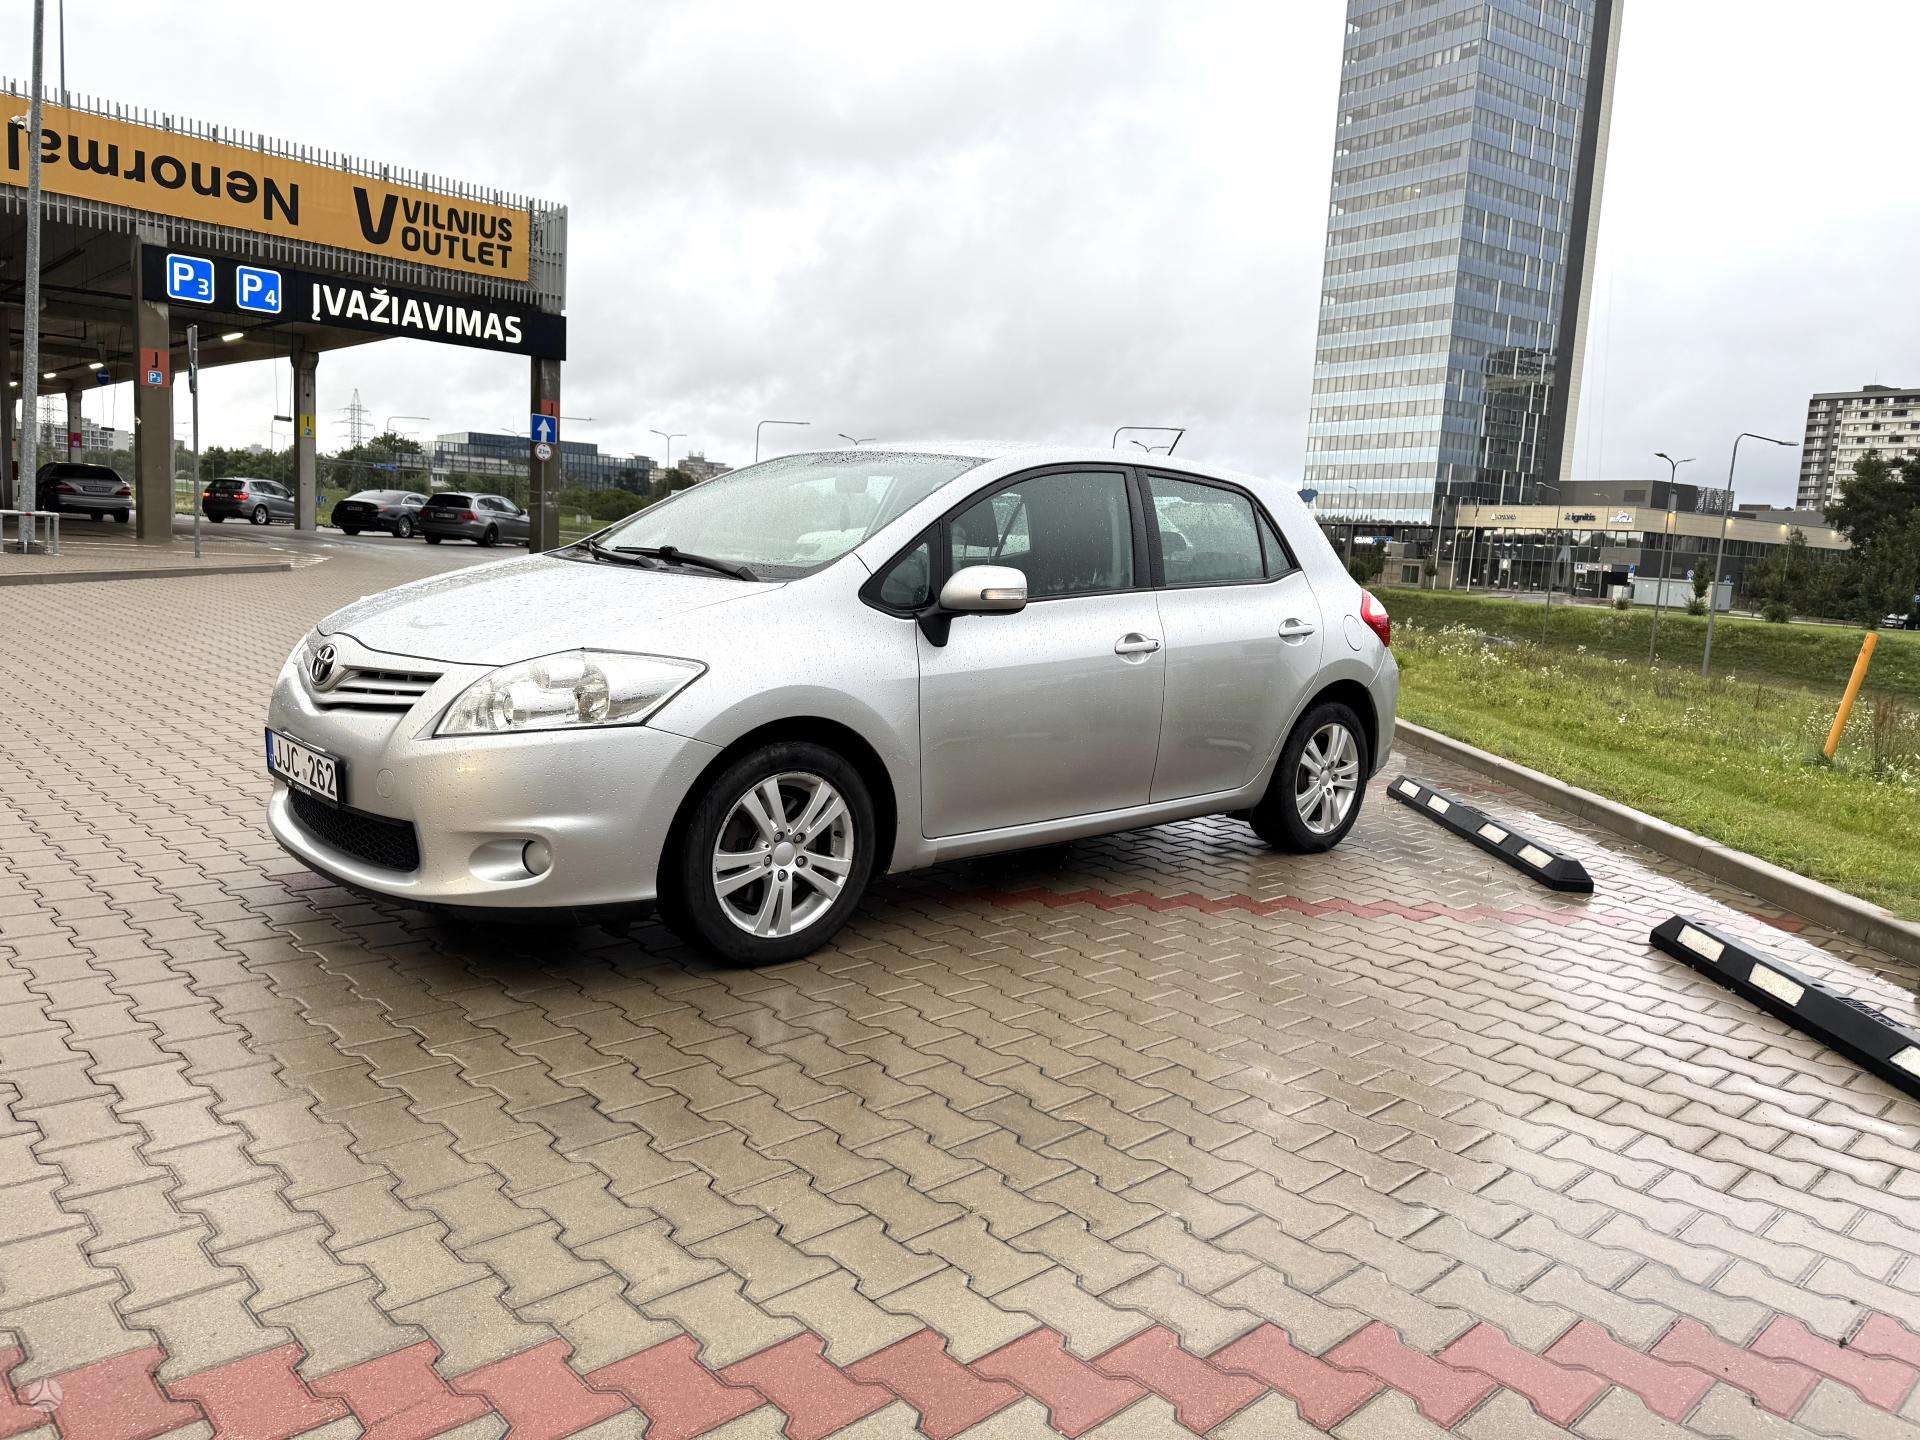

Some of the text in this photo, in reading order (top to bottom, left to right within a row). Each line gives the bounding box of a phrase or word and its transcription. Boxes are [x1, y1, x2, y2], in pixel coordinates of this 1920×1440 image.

[8, 122, 299, 226] Nenormal
[402, 197, 513, 242] VILNIUS
[401, 226, 513, 269] OUTLET
[311, 283, 523, 344] ĮVAŽIAVIMAS
[152, 351, 159, 368] J
[274, 739, 336, 797] JJC 262
